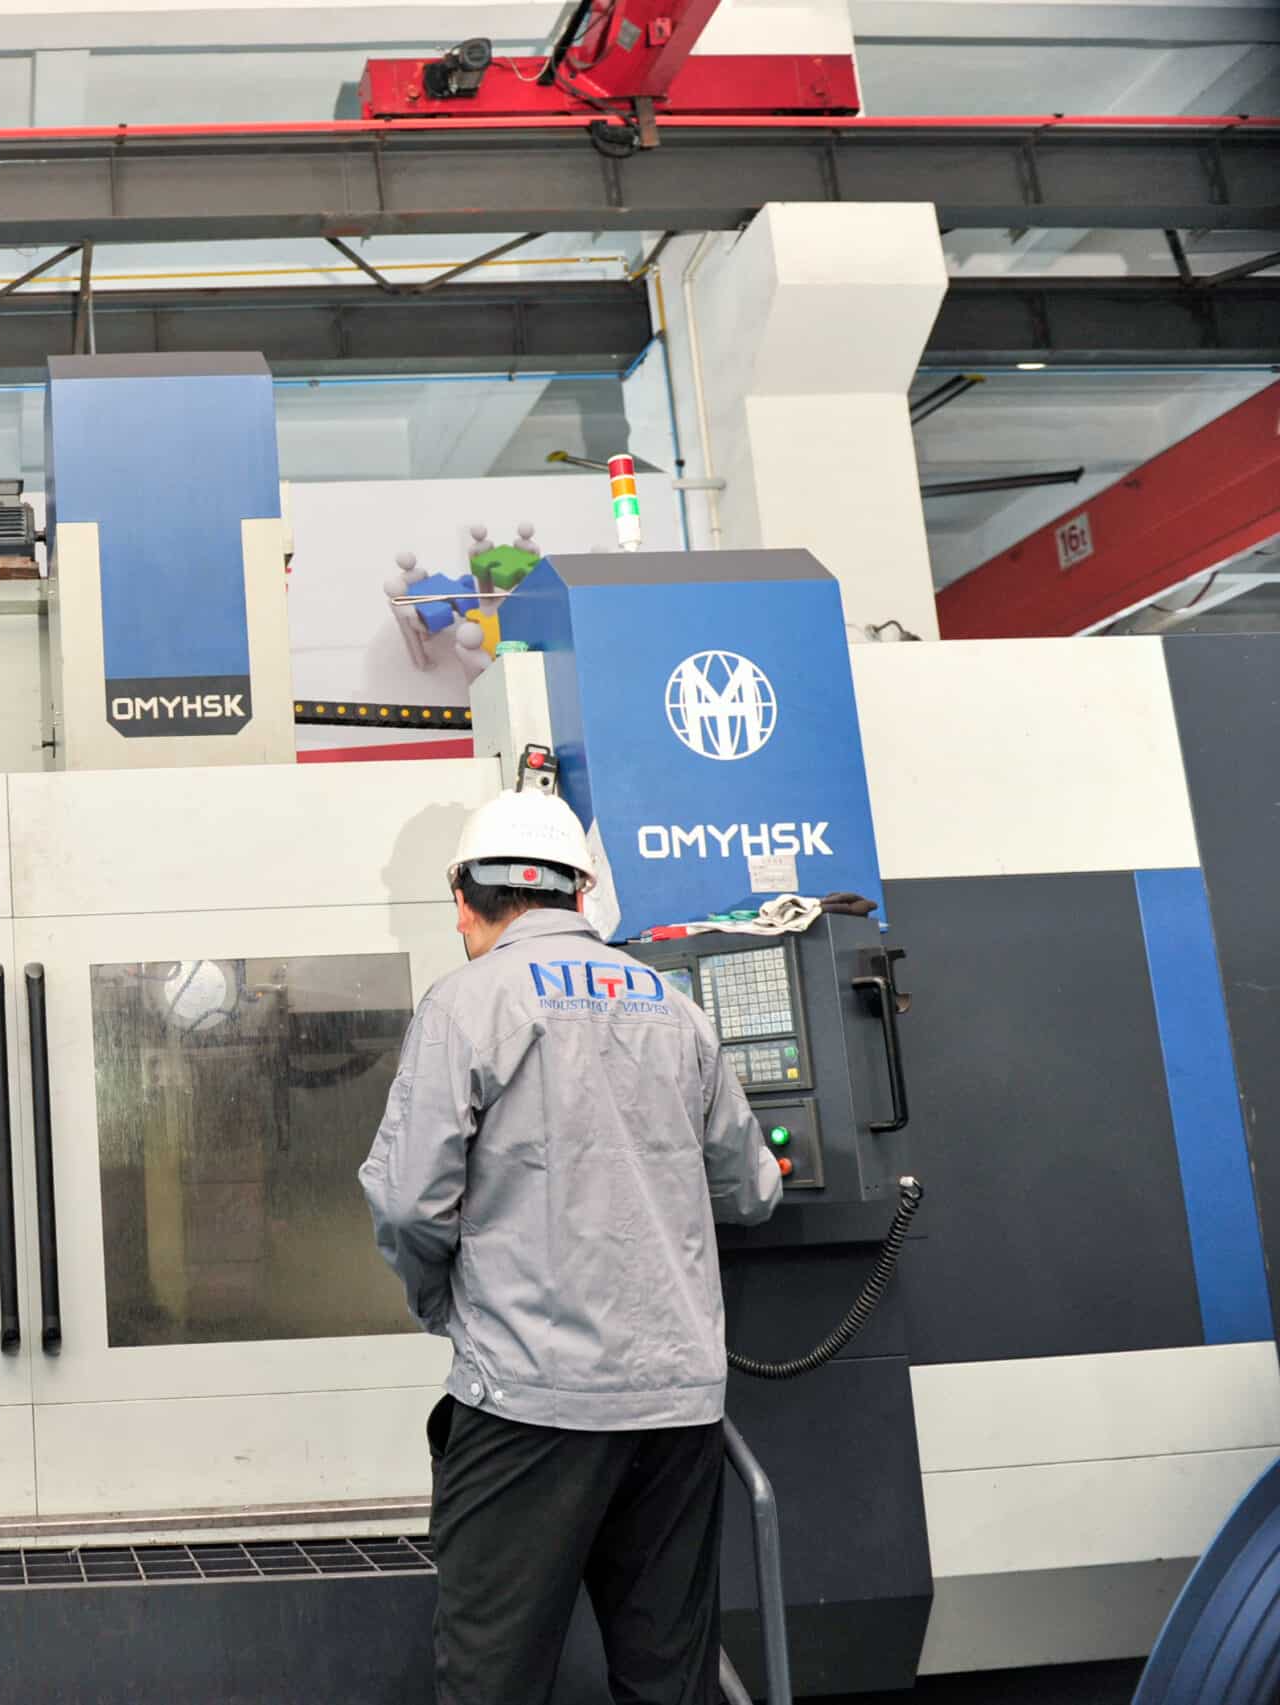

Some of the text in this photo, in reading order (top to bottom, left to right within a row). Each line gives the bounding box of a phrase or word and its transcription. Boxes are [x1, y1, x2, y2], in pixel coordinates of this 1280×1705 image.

[1060, 525, 1088, 557] 16t
[112, 694, 245, 721] OMYHSK
[637, 821, 834, 859] OMYHSK
[623, 1000, 671, 1015] VALVES
